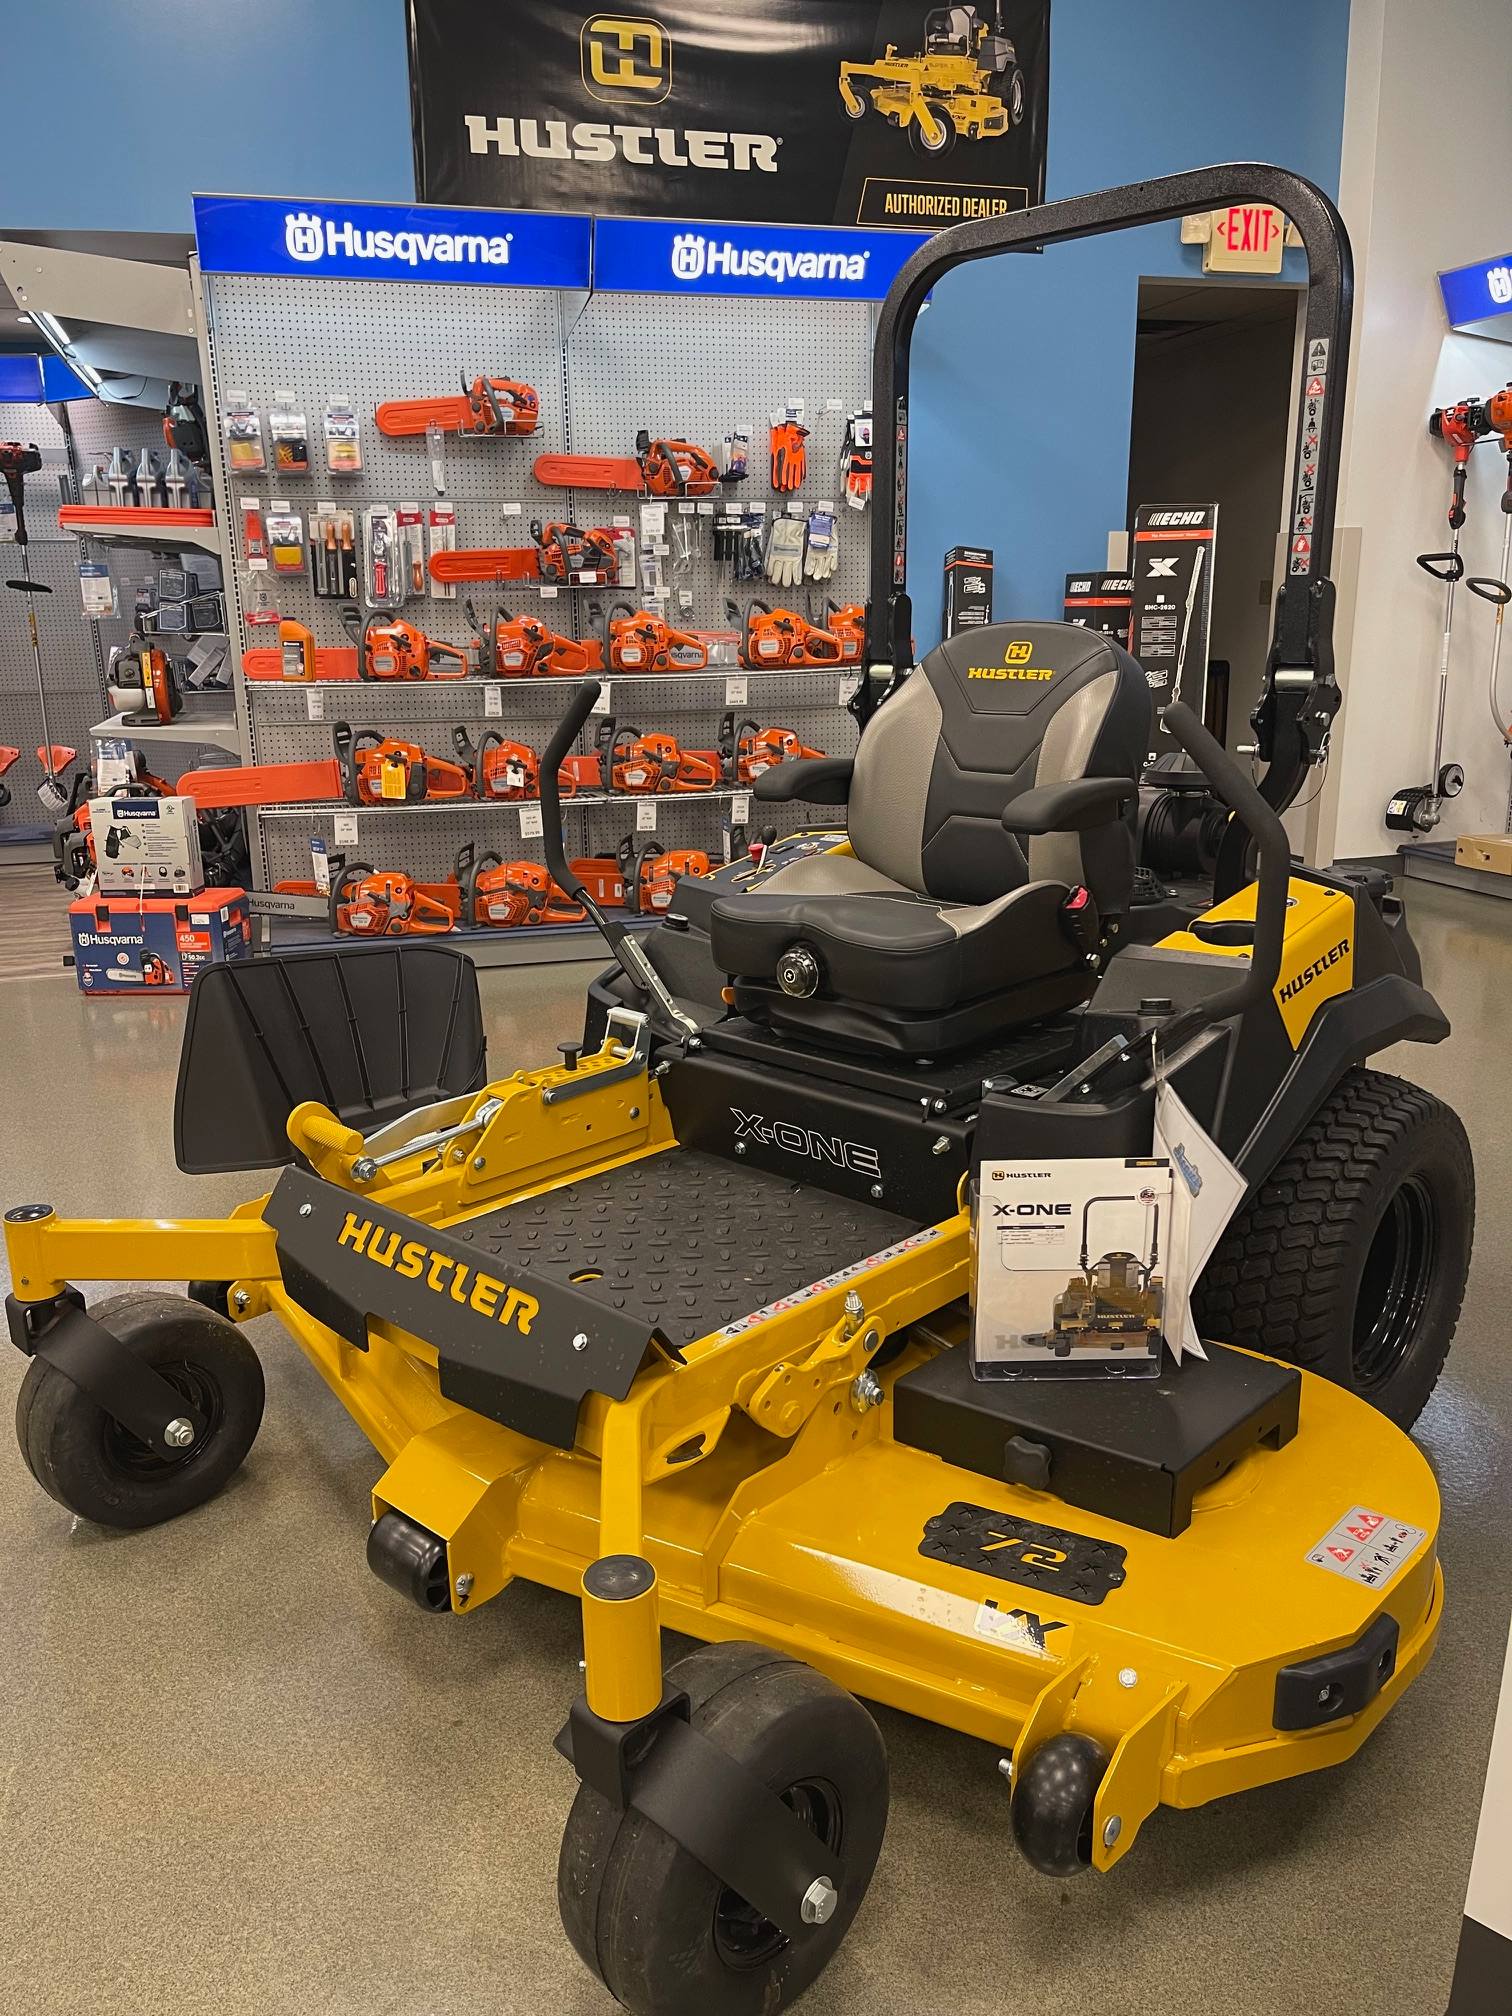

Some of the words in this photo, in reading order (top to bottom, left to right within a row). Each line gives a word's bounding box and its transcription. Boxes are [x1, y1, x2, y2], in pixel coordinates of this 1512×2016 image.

[464, 114, 779, 173] HUSTLER
[884, 193, 960, 217] AUTHORIZED
[962, 197, 1008, 218] DEALER
[325, 220, 509, 266] Husqvarna
[1228, 208, 1273, 252] EXIT
[706, 241, 866, 283] Husqvarna
[1158, 511, 1206, 526] ECHO
[967, 667, 1053, 681] HUSTLER
[123, 809, 156, 818] Husqvarna
[90, 934, 144, 947] Husqvarna
[179, 934, 195, 942] 450
[1279, 938, 1350, 1005] HUSTLER
[729, 1106, 882, 1179] X-ONE
[992, 1203, 1072, 1217] X-ONE
[337, 1212, 540, 1336] HUSTLER
[979, 1530, 1068, 1572] 72
